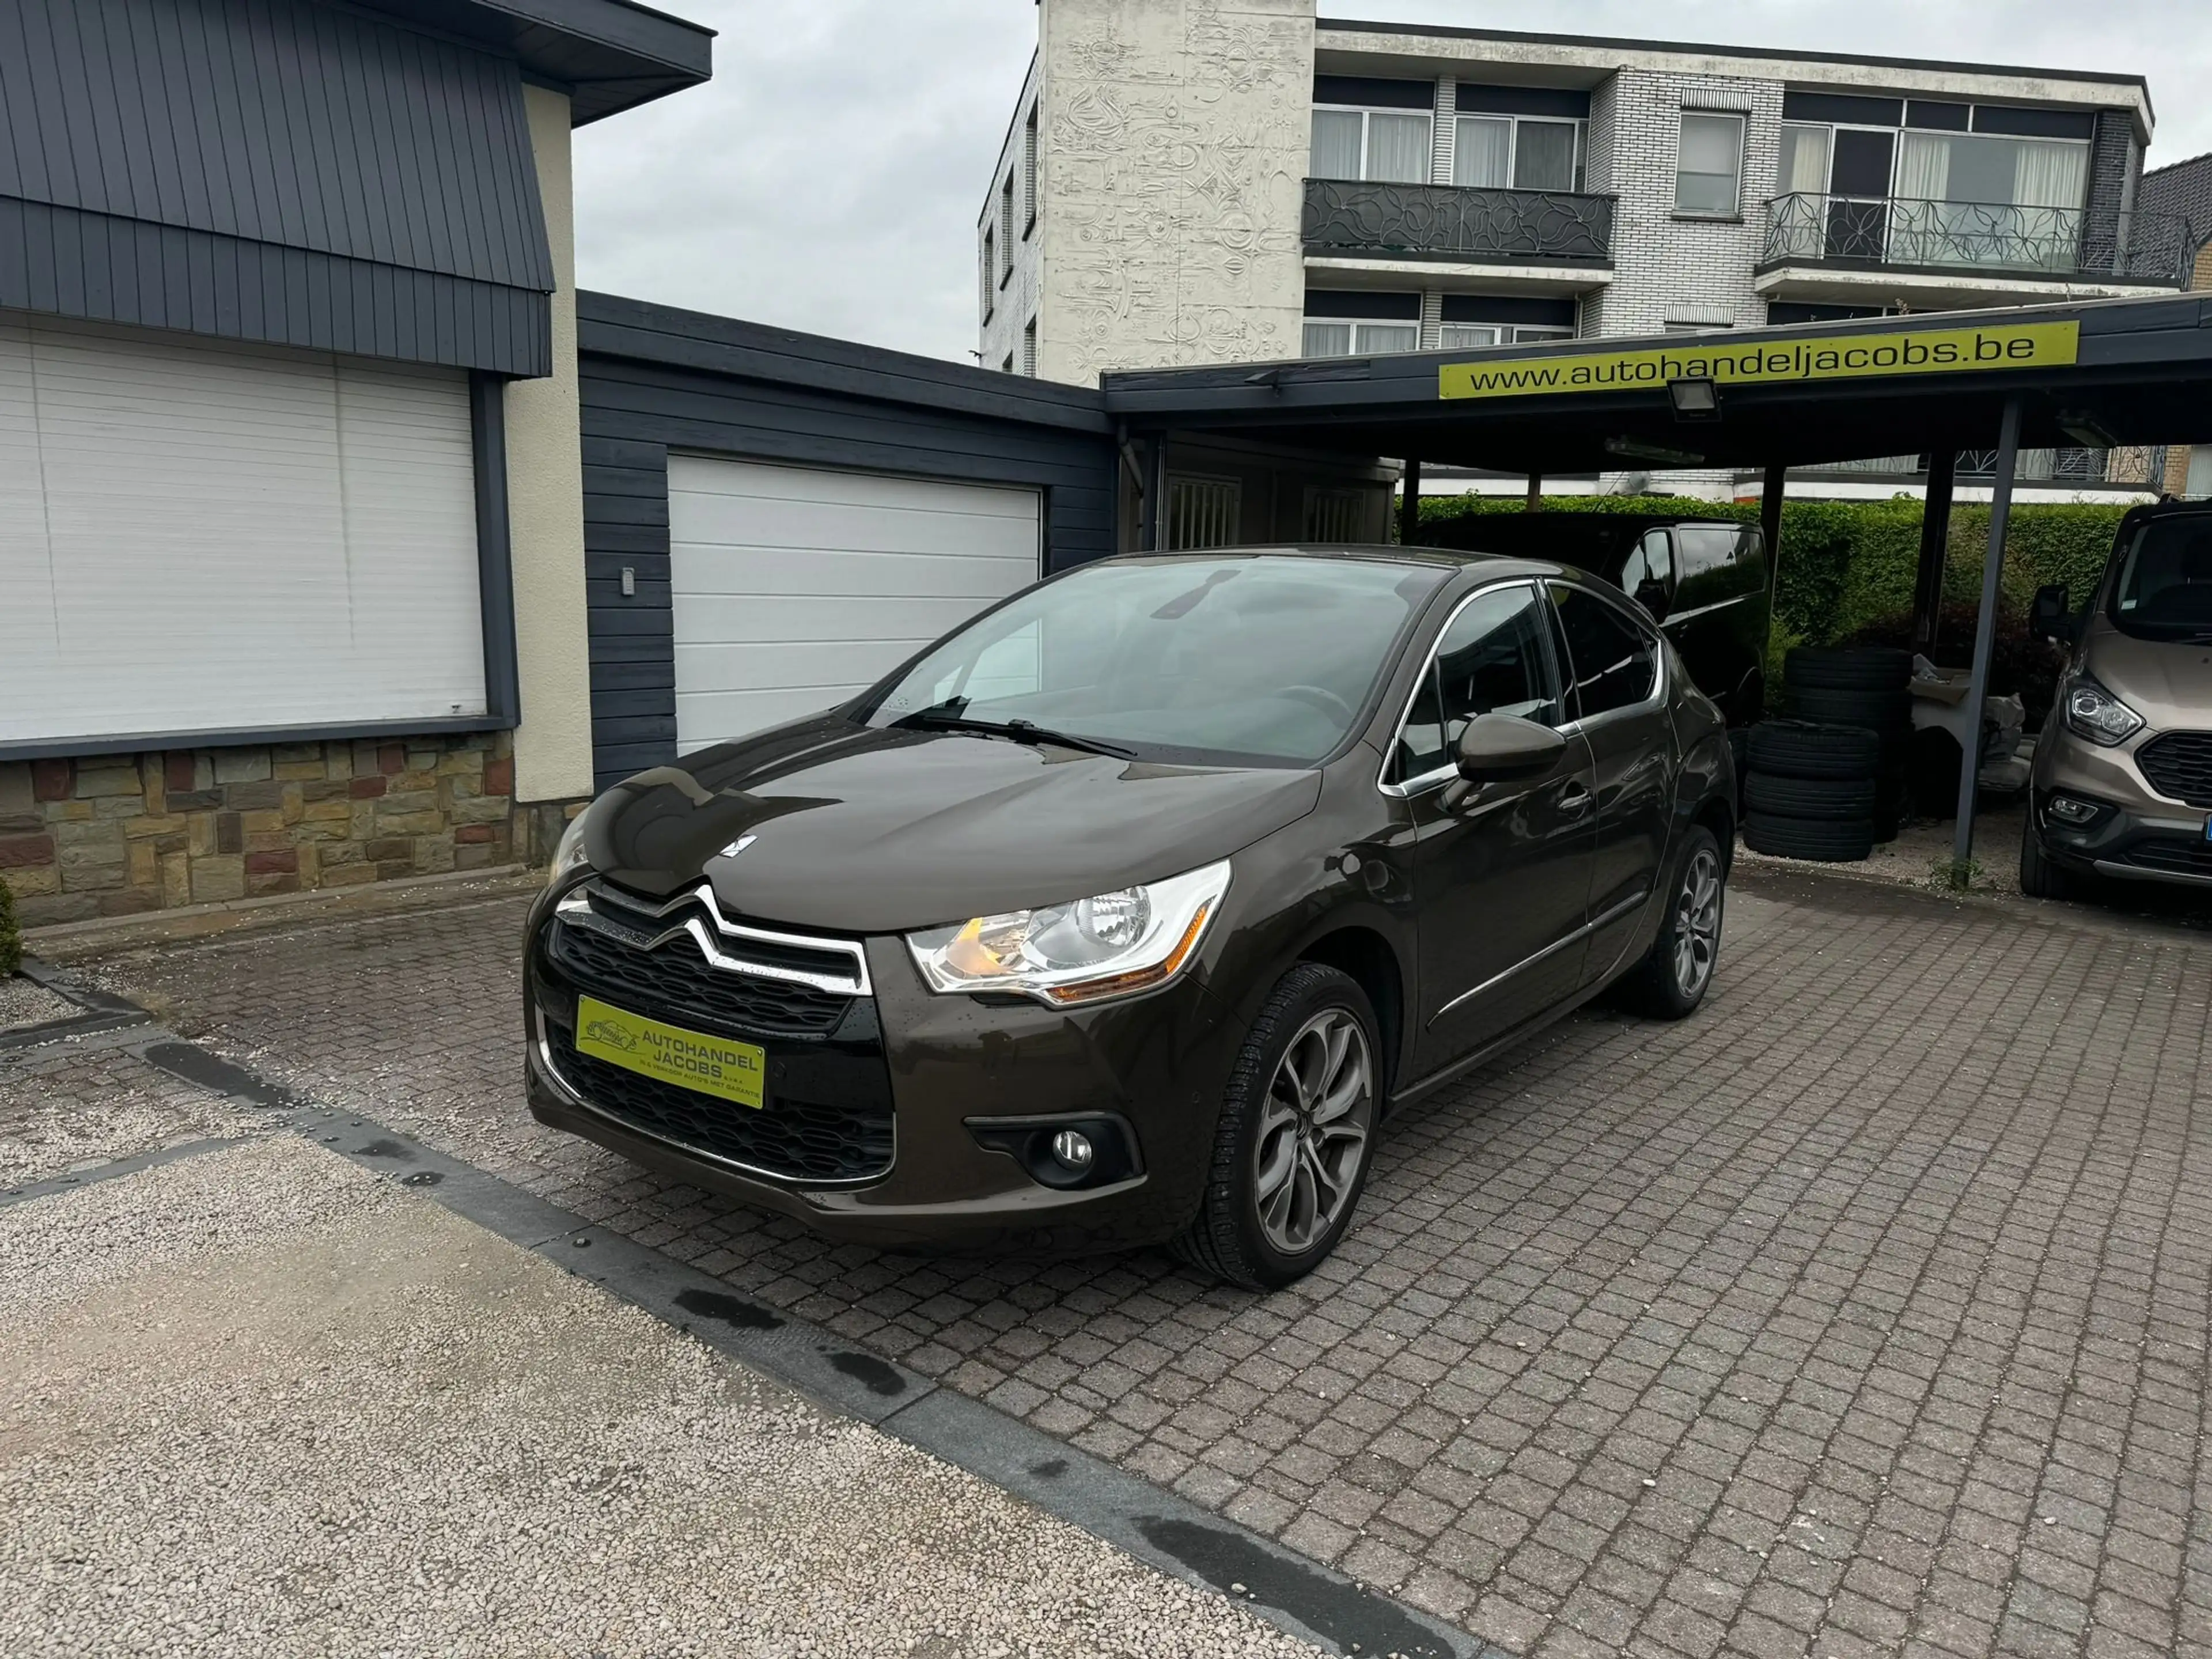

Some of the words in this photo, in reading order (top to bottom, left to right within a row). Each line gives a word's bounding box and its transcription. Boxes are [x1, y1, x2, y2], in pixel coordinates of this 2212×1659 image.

[1470, 334, 2035, 391] www.autohandeljacobs.be
[642, 1030, 758, 1071] AUTOHANDEL
[653, 1050, 722, 1078] JACOBS
